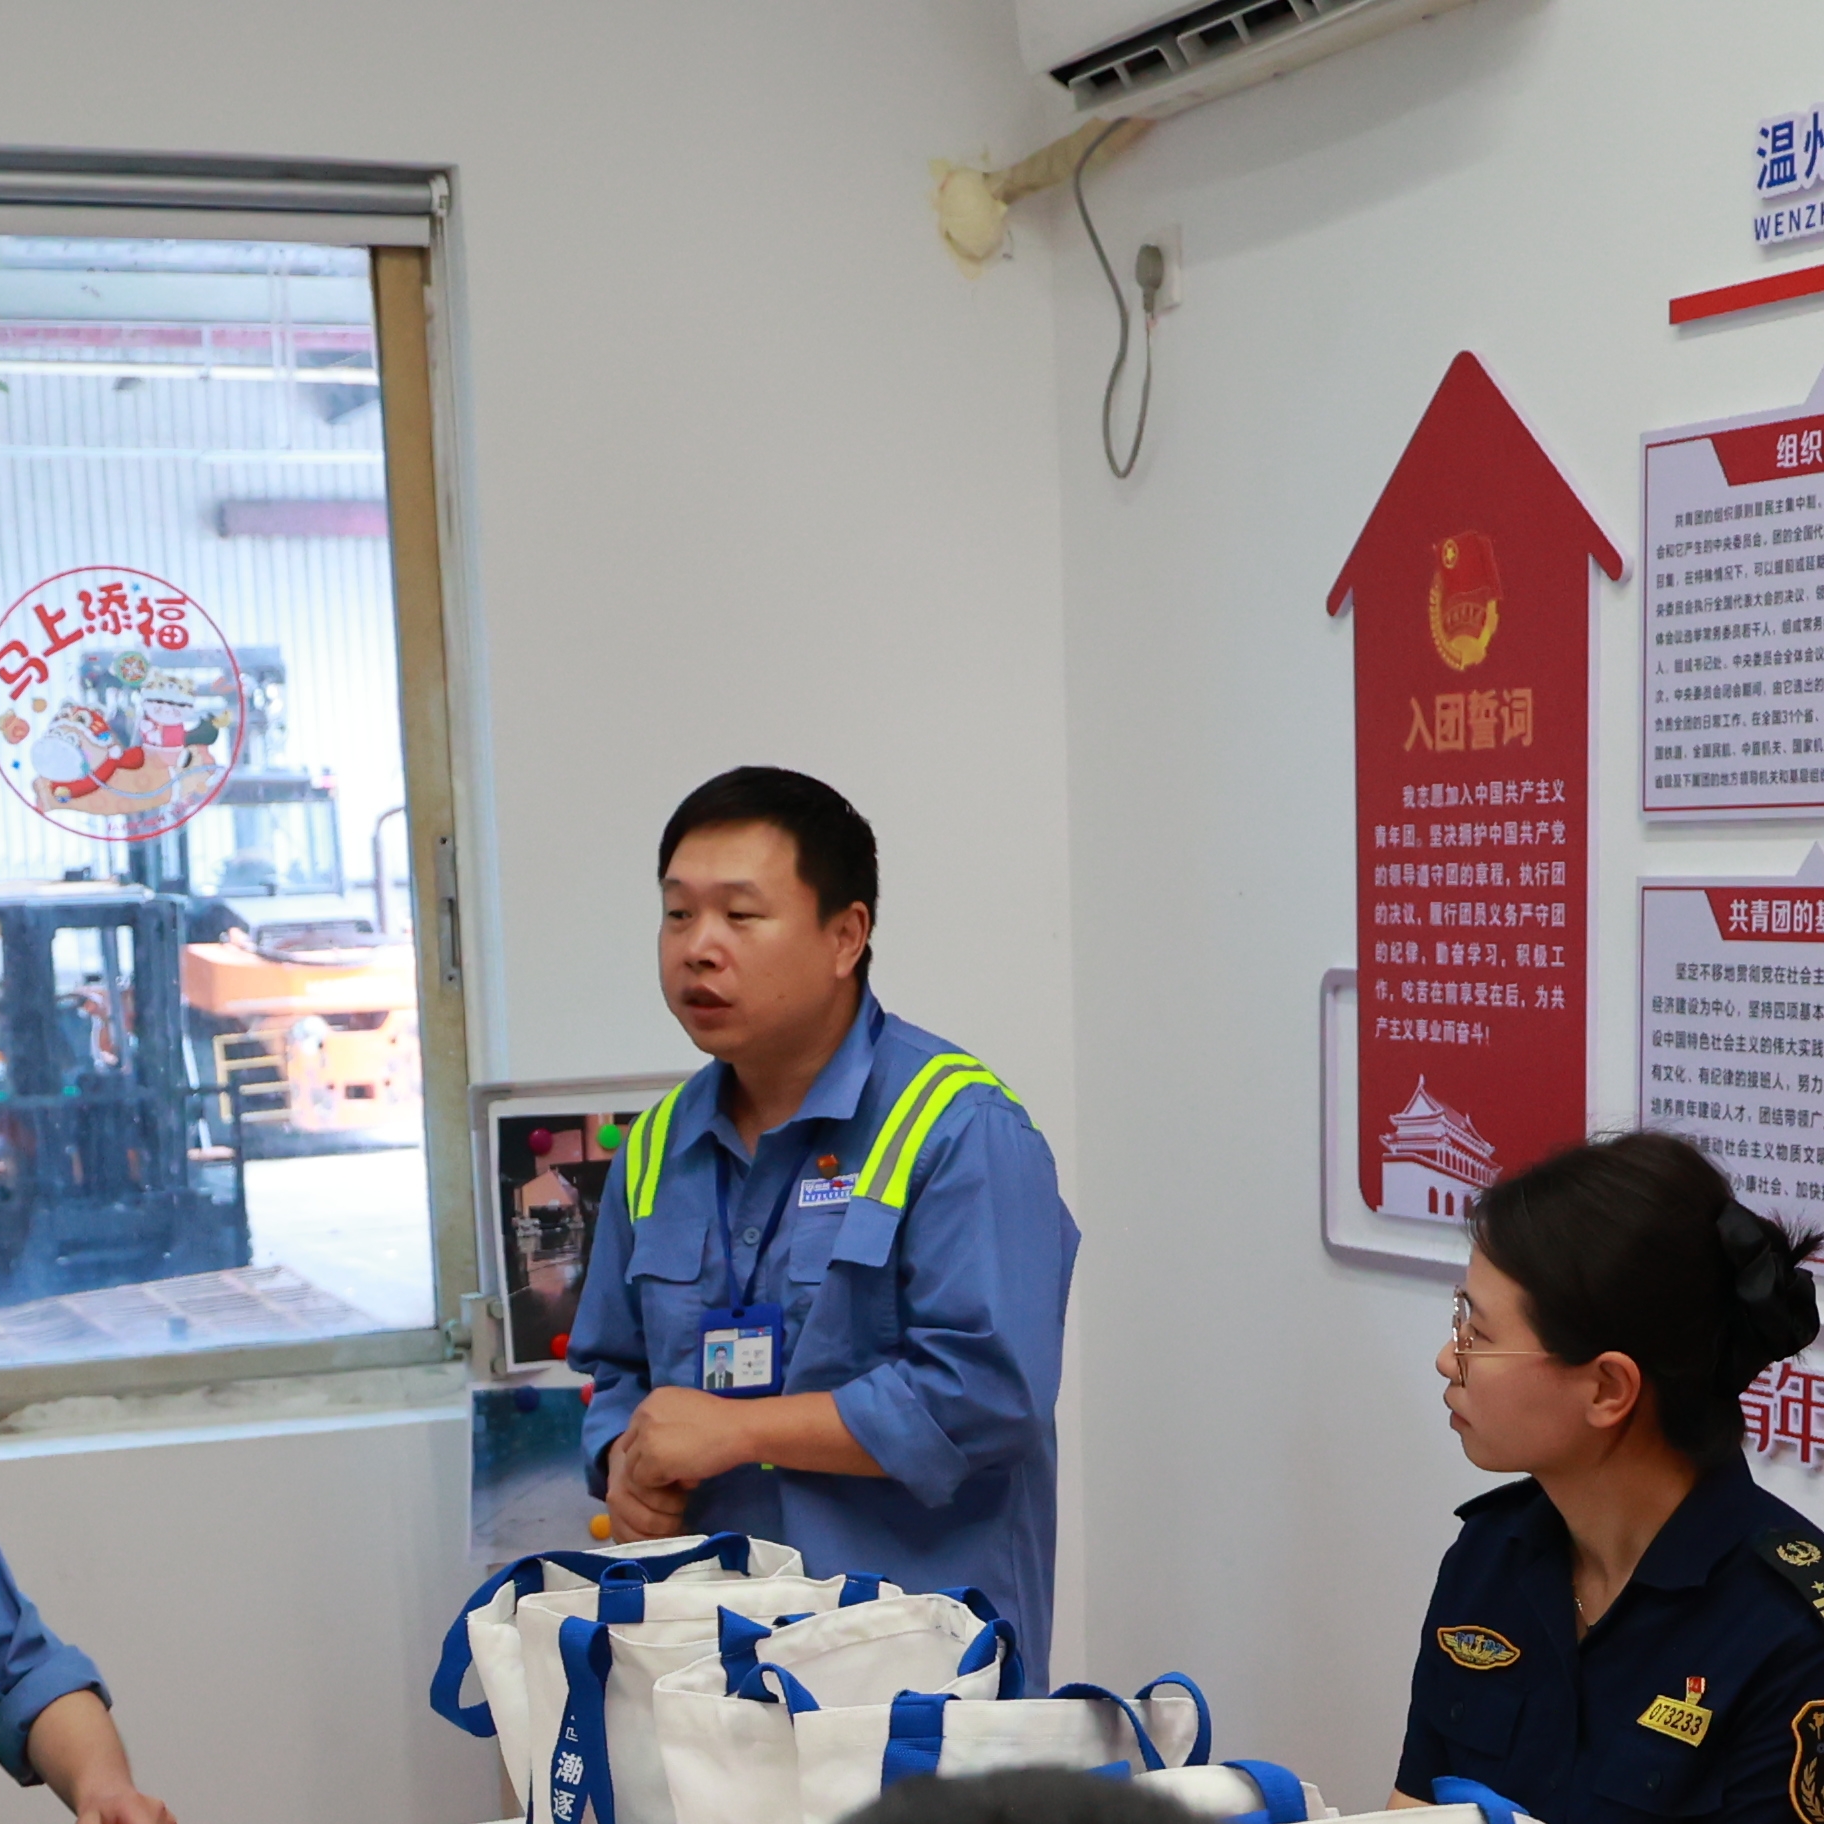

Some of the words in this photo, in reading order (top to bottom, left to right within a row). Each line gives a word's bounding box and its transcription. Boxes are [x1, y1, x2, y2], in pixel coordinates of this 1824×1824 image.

[1403, 687, 1533, 752] 入团誓词
[1648, 1702, 1705, 1736] 073233
